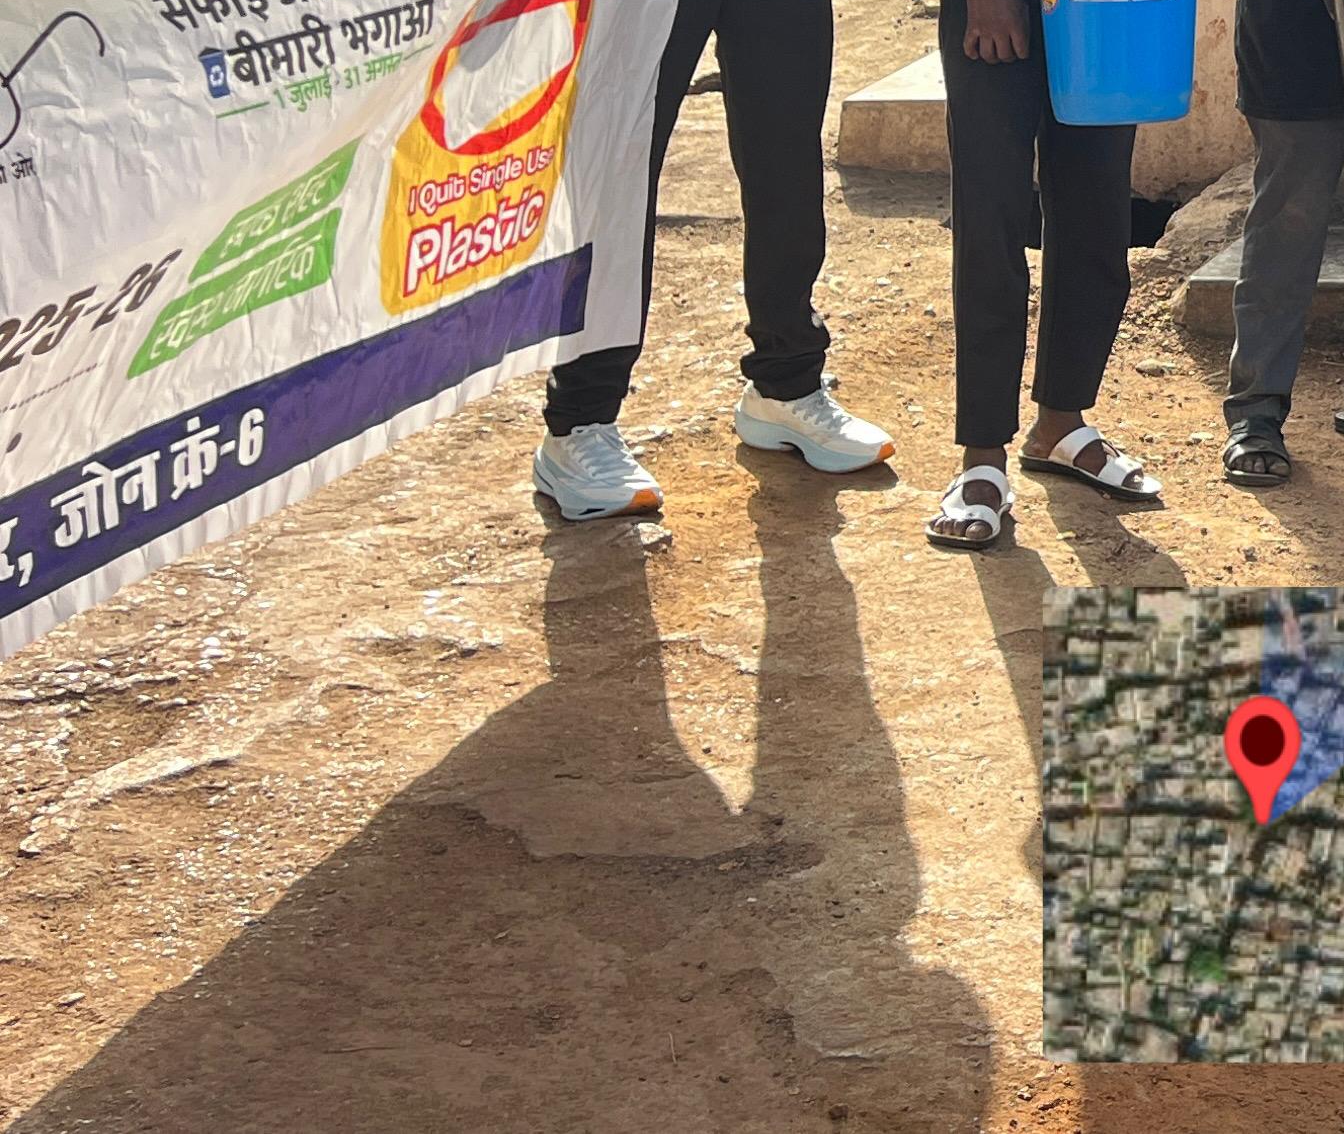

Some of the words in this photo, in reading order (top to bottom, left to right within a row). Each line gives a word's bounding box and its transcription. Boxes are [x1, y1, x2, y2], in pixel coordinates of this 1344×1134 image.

[225, 13, 336, 87] बीमारी
[273, 88, 286, 109] 1
[283, 66, 333, 112] जुलाई
[343, 66, 361, 89] 31
[418, 173, 467, 216] Quit
[468, 155, 524, 194] Single
[402, 185, 546, 298] Plastic
[50, 460, 161, 549] जोन
